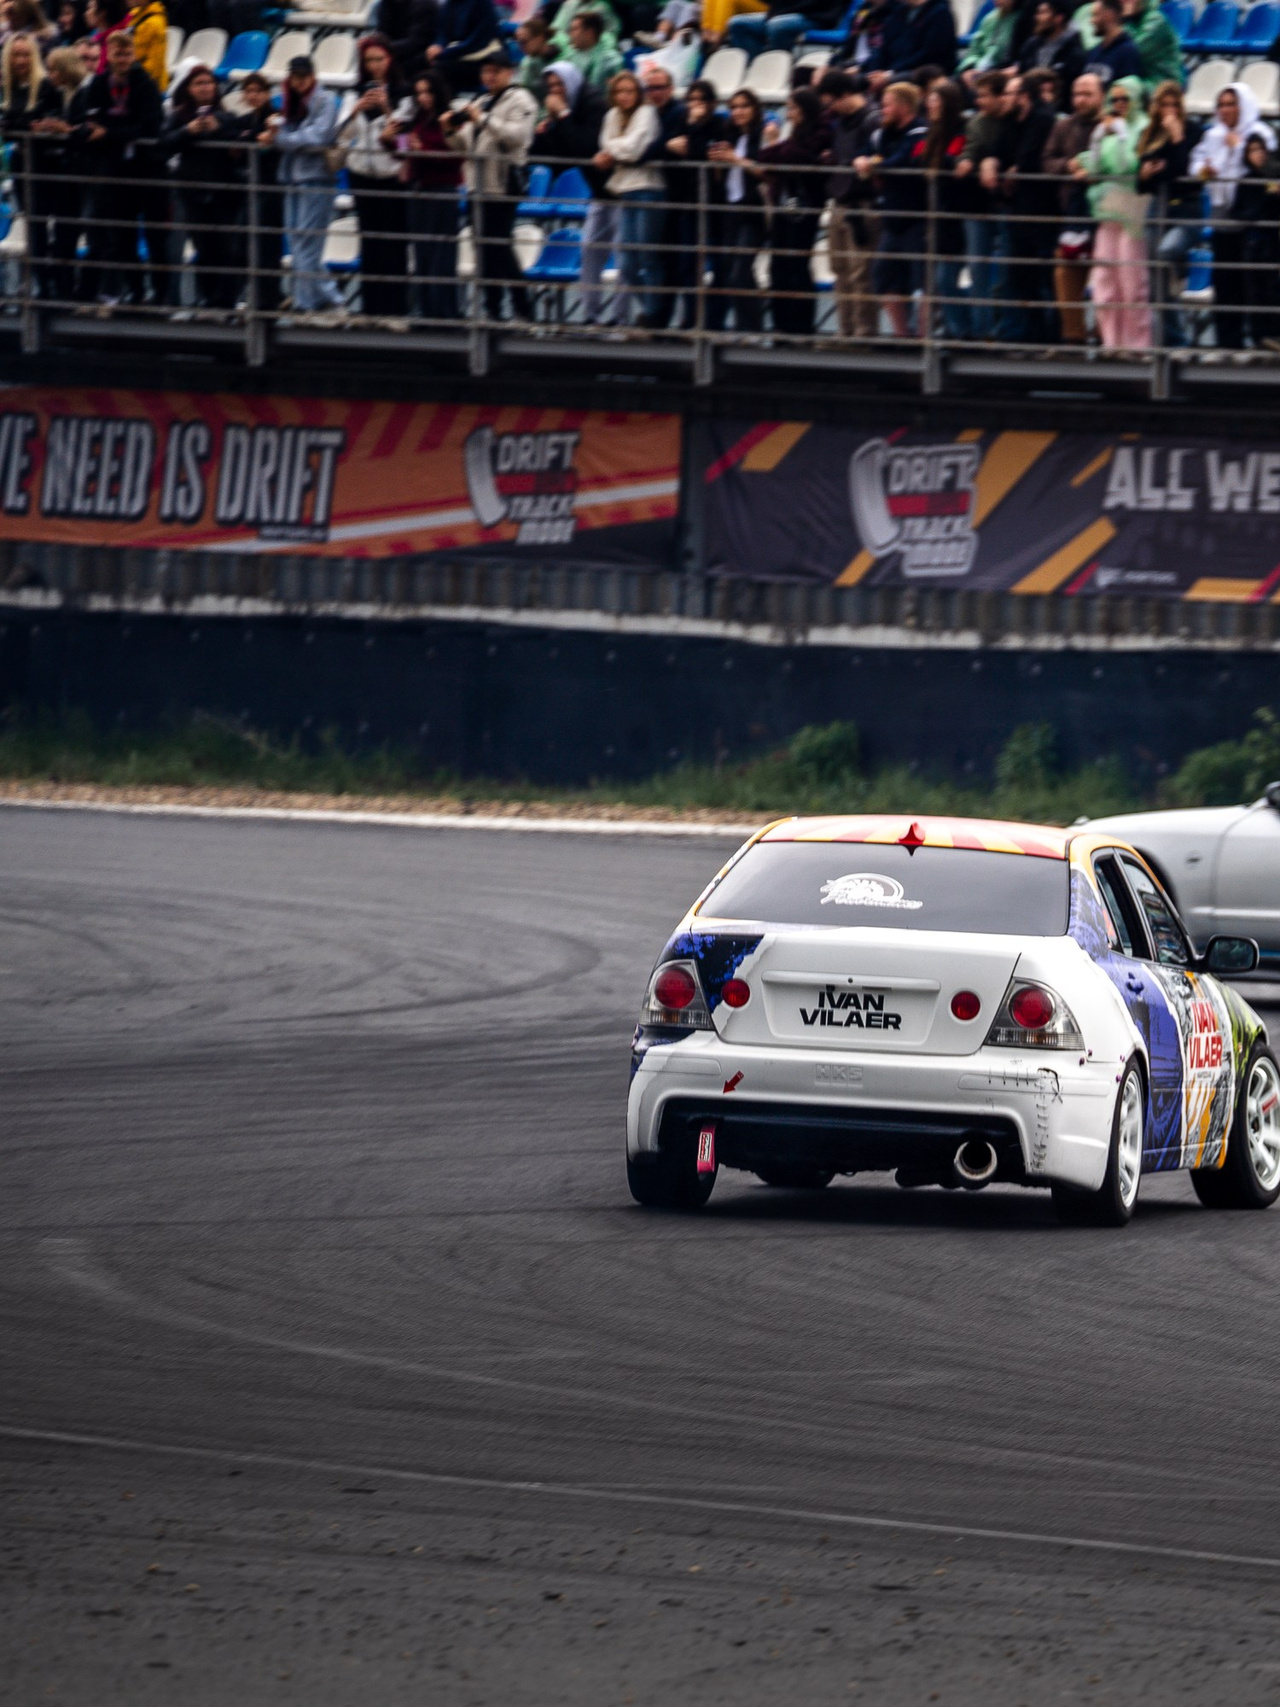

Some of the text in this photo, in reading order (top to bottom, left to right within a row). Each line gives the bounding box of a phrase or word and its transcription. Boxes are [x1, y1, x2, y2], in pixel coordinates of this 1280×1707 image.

[497, 432, 580, 471] DRIFT
[42, 417, 153, 515] NEED
[159, 421, 210, 518] IS
[215, 426, 344, 524] DRIFT
[889, 455, 974, 492] DRIFT
[1103, 446, 1195, 512] ALL
[818, 990, 885, 1011] IVAN
[1191, 1001, 1217, 1034] IVAN
[799, 1007, 902, 1031] VILAER
[1188, 1034, 1223, 1069] VILAER
[814, 1064, 863, 1086] HKS
